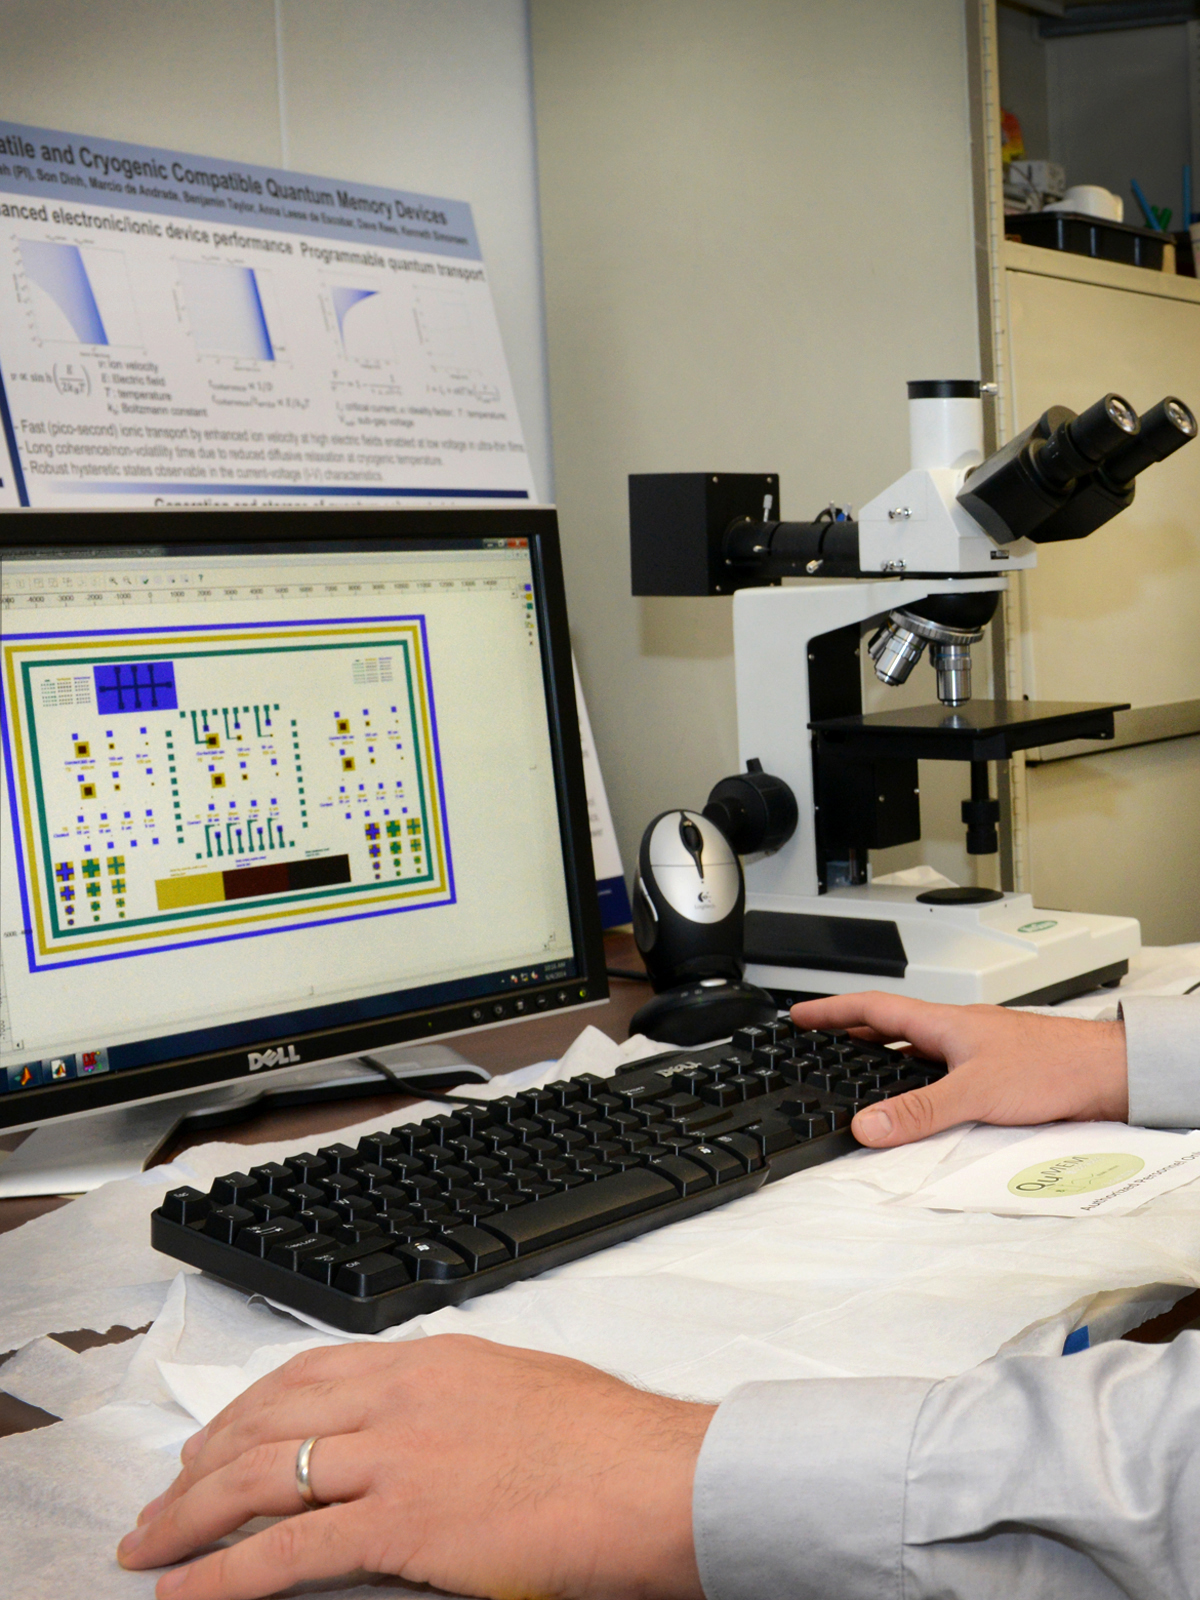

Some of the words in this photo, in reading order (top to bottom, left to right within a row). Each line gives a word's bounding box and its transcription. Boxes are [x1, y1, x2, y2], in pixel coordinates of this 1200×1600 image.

[41, 144, 75, 165] and
[79, 146, 168, 180] Cryogenic
[171, 163, 262, 195] Compatible
[266, 178, 335, 207] Quantum
[336, 190, 392, 220] Memory
[394, 200, 447, 226] Devices
[0, 203, 48, 223] anced
[52, 207, 162, 236] electronic/ionic
[165, 223, 209, 244] device
[212, 230, 293, 255] performance
[300, 241, 385, 268] Programmable
[388, 257, 436, 275] quantum
[437, 263, 486, 283] transport
[20, 420, 46, 435] Fast
[48, 421, 118, 439] (pico-second)
[146, 425, 188, 440] transport
[24, 441, 53, 458] Long
[30, 460, 69, 476] Robust
[71, 462, 121, 479] hysteretic
[247, 1045, 300, 1071] DELL
[1081, 1183, 1140, 1211] Authorized
[1134, 1160, 1187, 1183] Personnel
